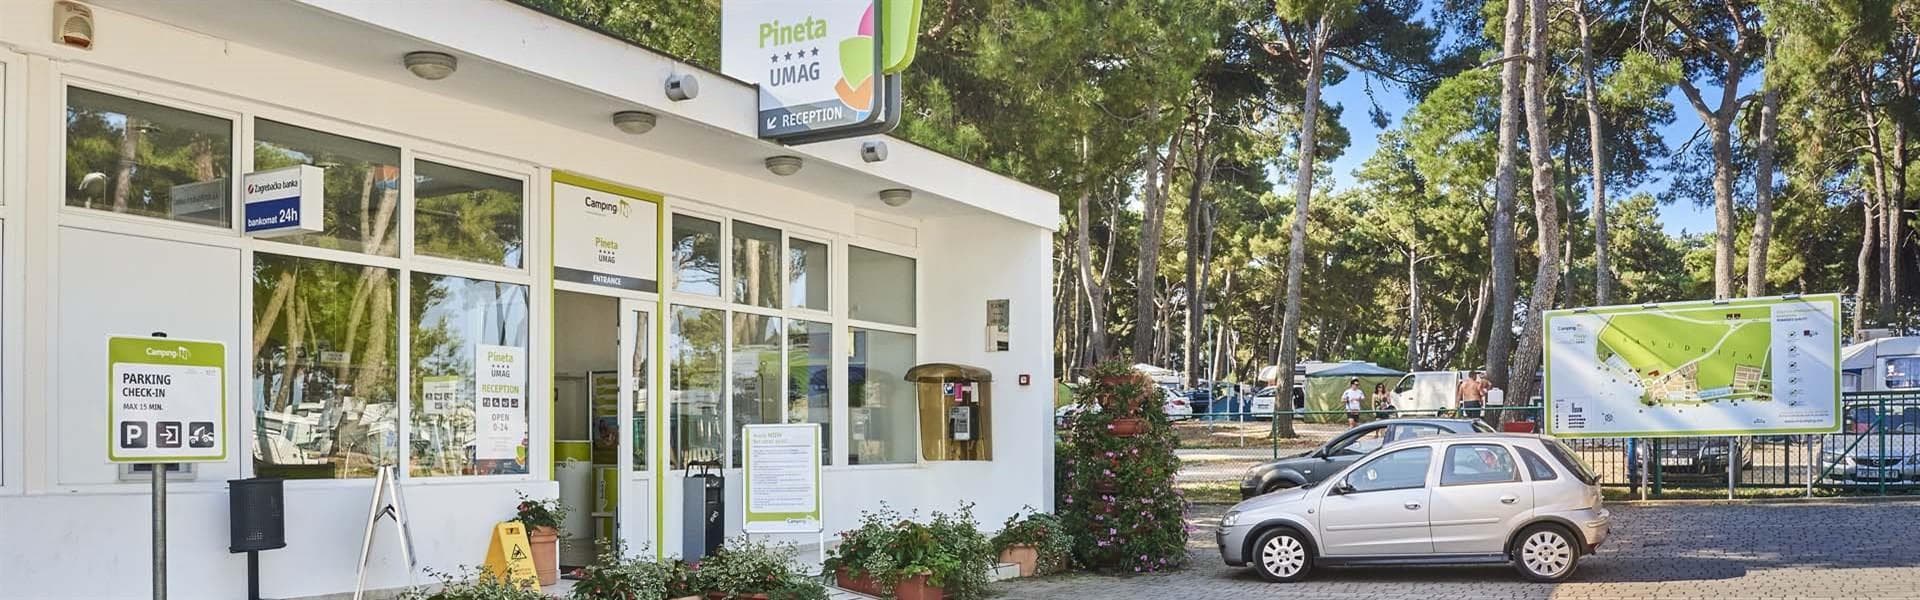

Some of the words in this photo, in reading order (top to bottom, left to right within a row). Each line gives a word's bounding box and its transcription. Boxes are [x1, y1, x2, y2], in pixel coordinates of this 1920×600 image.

[759, 16, 827, 48] Pineta
[770, 62, 820, 87] UMAG
[782, 106, 843, 127] RECEPTION
[283, 180, 298, 189] banka
[584, 196, 618, 214] Camping
[248, 216, 278, 227] bankomat
[279, 208, 298, 223] 24h
[595, 237, 618, 250] Pineta
[598, 254, 616, 264] UMAG
[592, 274, 622, 285] ENTRANCE
[145, 347, 178, 358] Camping
[487, 351, 514, 363] Pineta
[122, 373, 171, 385] PARKING
[491, 369, 511, 378] UMAG
[122, 387, 166, 398] CHECK-IN
[482, 384, 520, 394] RECEPTION
[123, 403, 138, 411] MAX
[139, 403, 148, 411] 15
[149, 403, 164, 411] MIN.
[491, 413, 510, 421] OPEN
